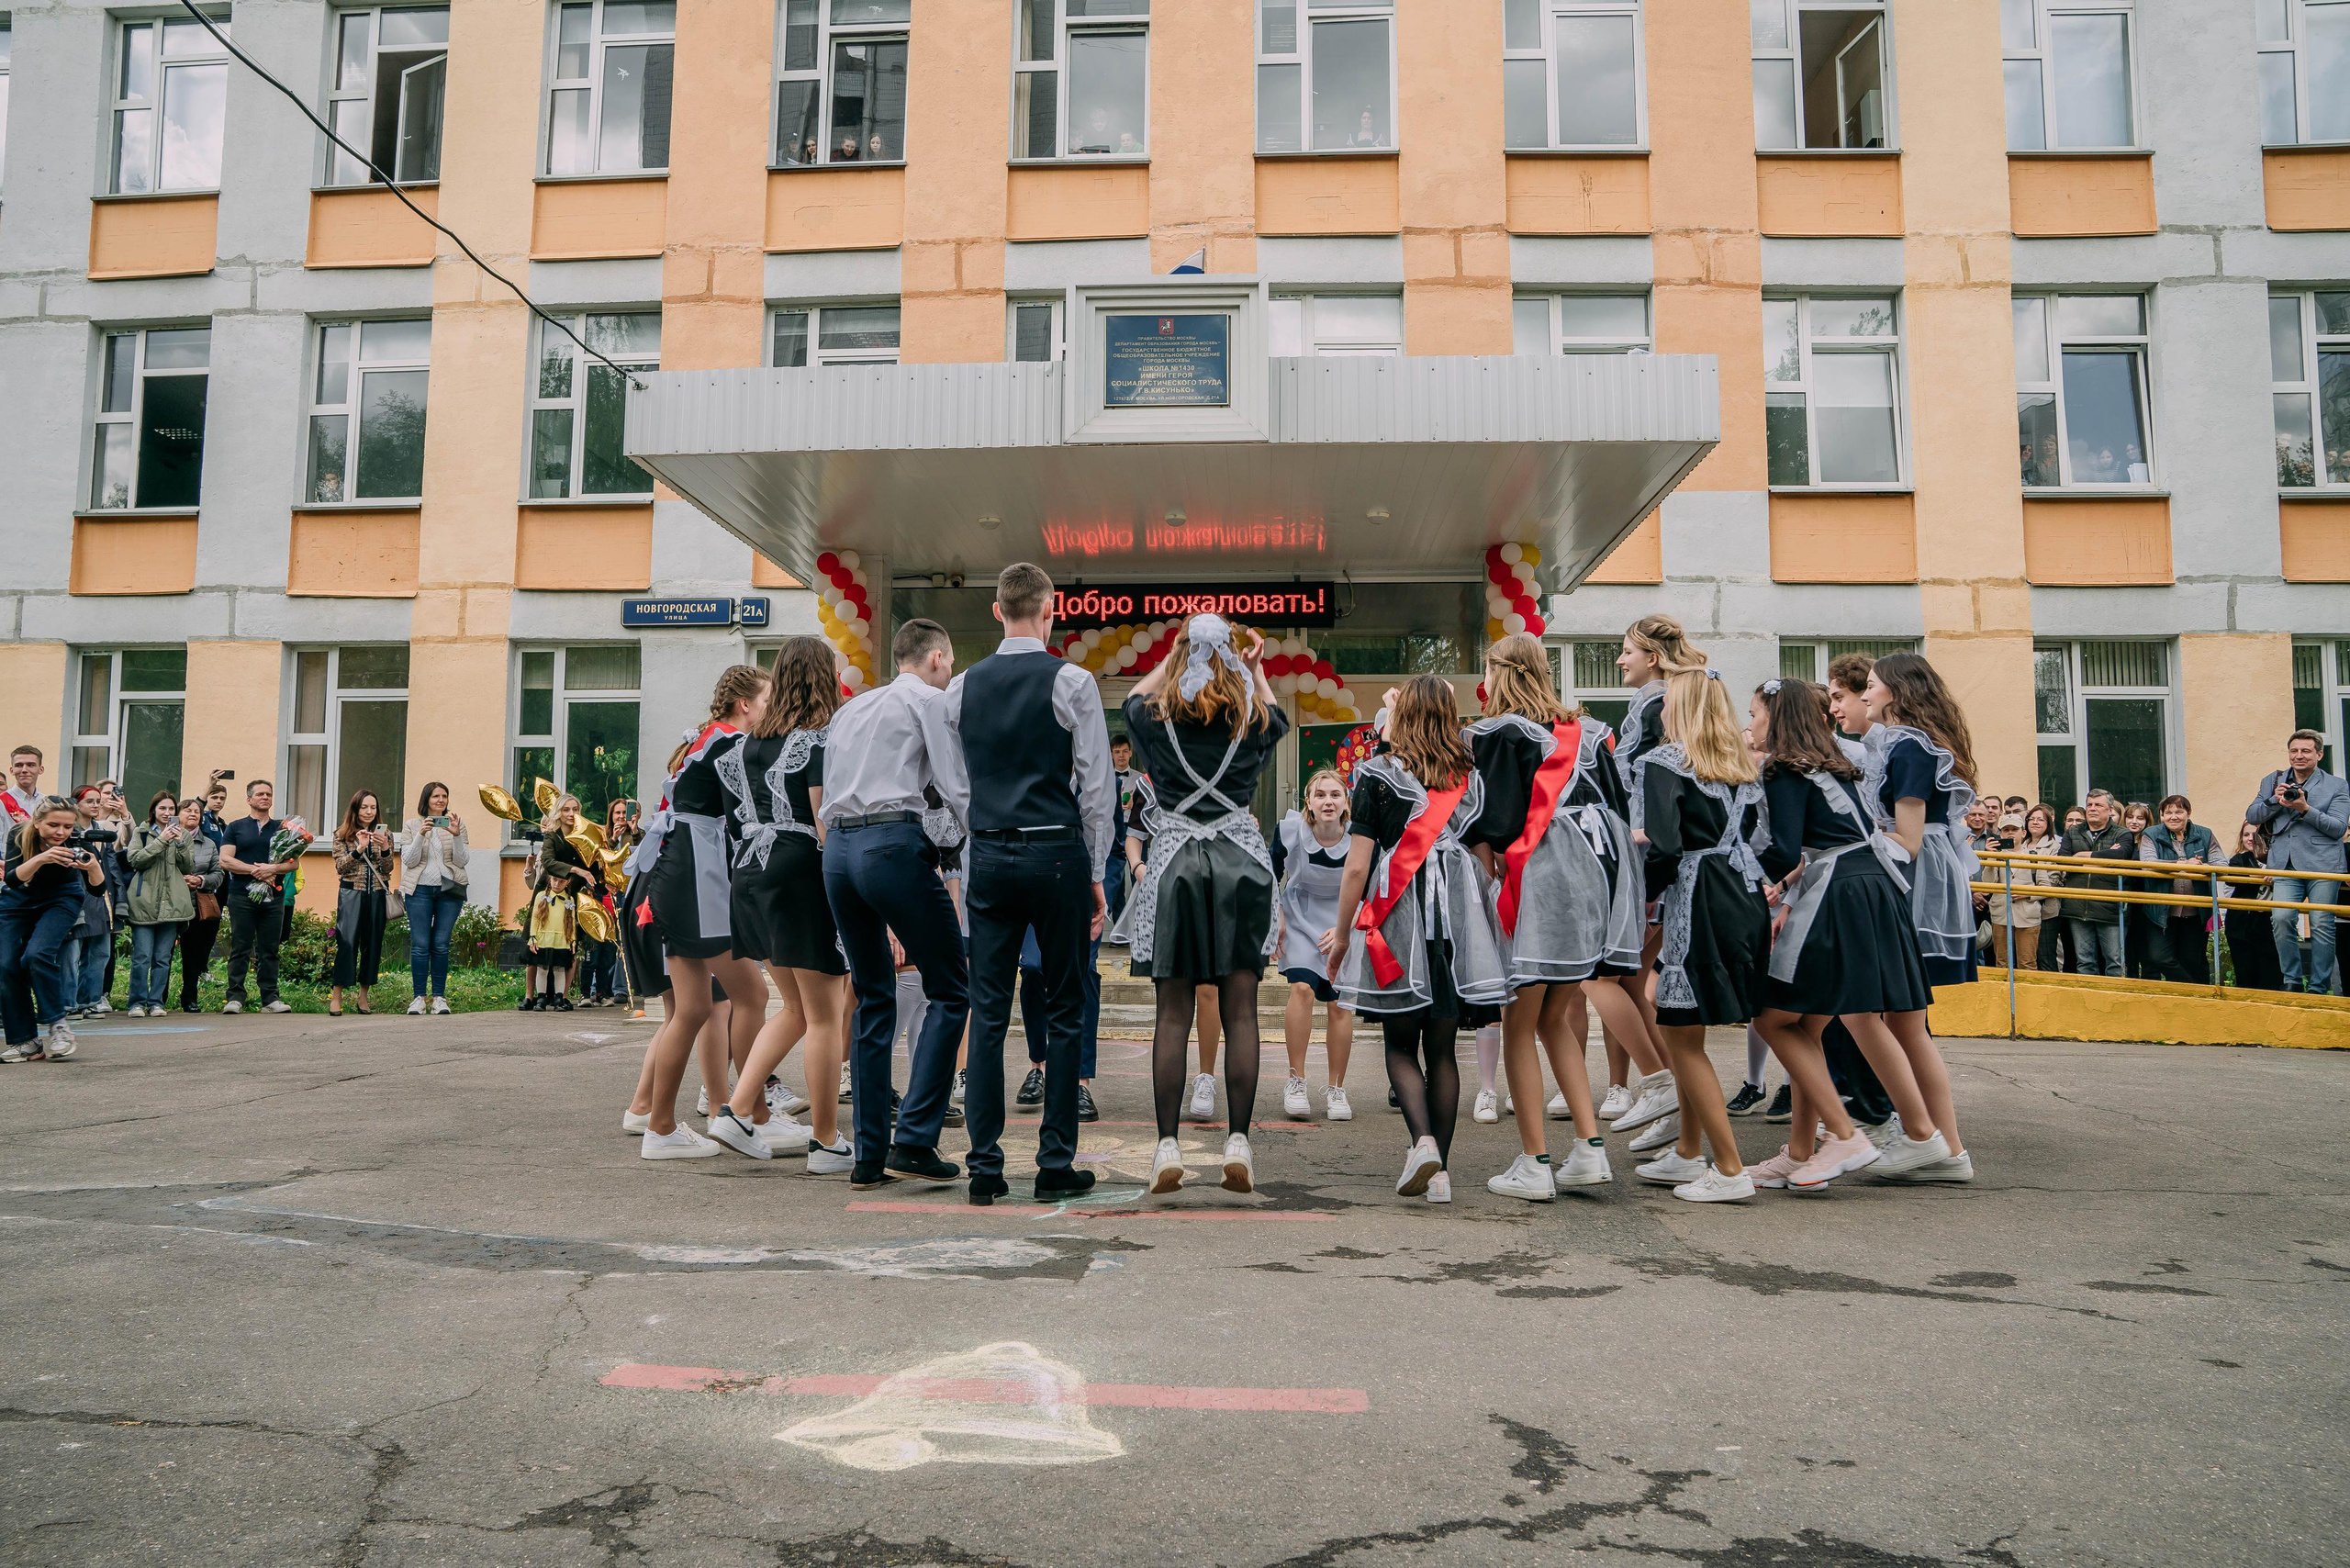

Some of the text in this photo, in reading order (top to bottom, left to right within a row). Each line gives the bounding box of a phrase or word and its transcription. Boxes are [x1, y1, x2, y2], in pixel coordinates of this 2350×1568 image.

[636, 603, 717, 613] НОВГОРОДСКАЯ
[1053, 588, 1325, 622] Добро пожаловать!
